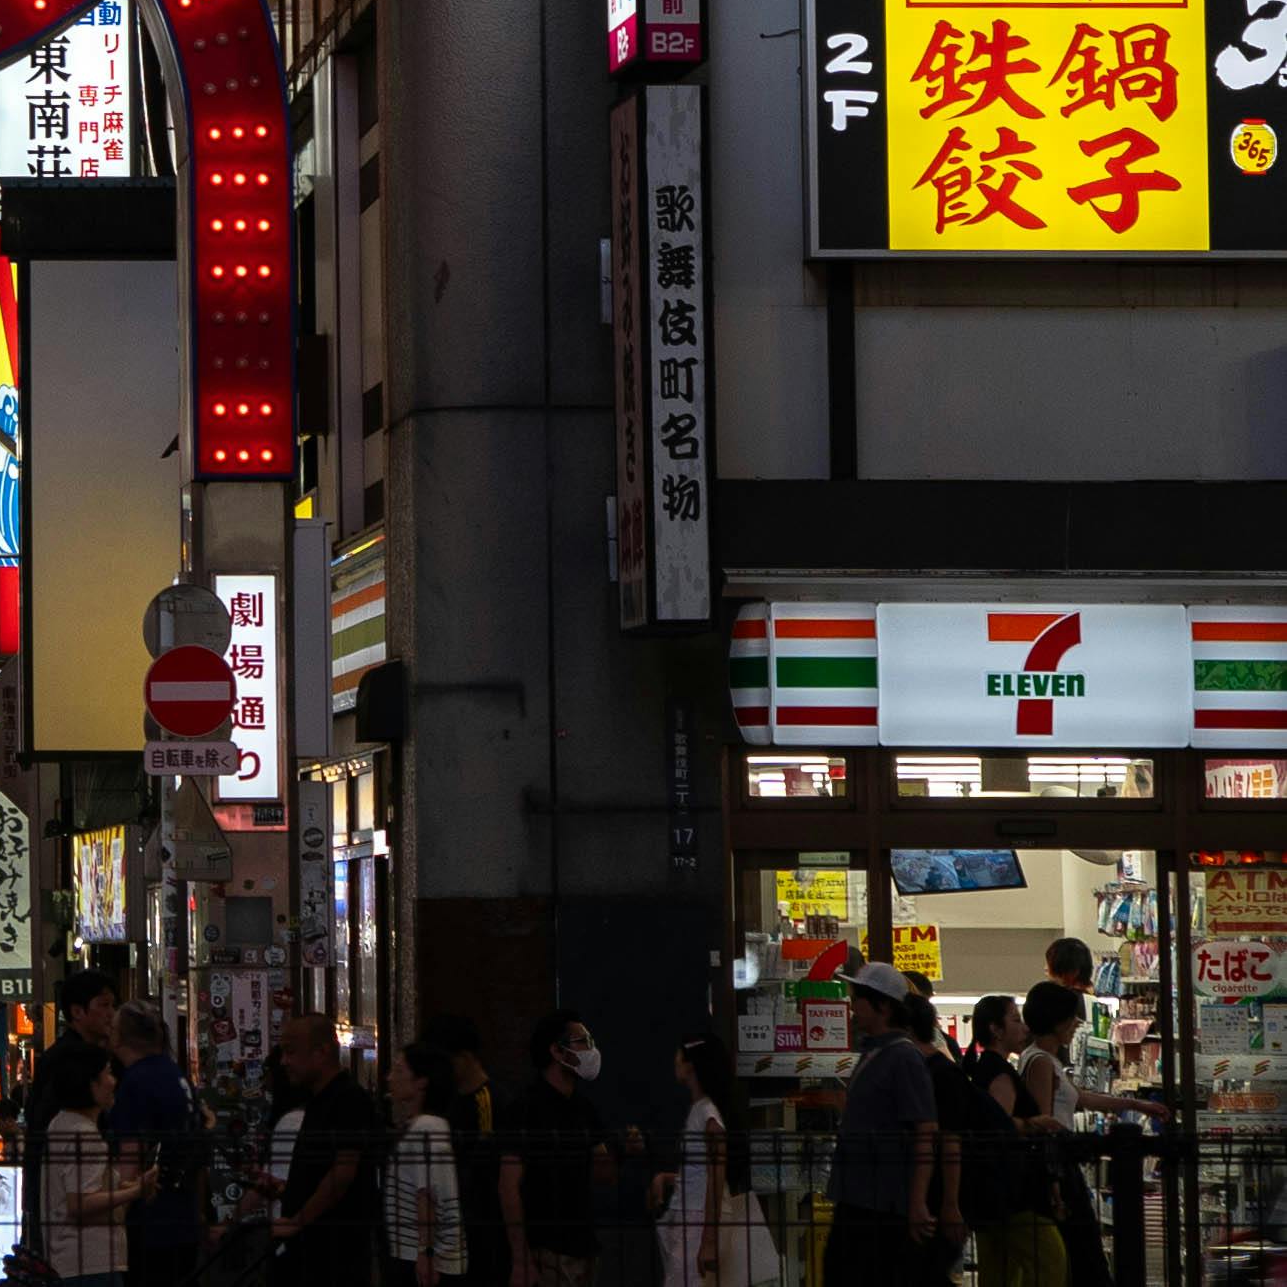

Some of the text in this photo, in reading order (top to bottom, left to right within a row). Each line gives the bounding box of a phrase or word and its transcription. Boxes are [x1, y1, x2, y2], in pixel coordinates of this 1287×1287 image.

[651, 31, 695, 55] B2F
[823, 33, 879, 132] 2F
[911, 19, 1179, 122] 鉄鍋
[102, 33, 124, 161] リーチ麻雀
[77, 84, 101, 178] 専門店
[1238, 131, 1270, 169] 365
[912, 127, 1183, 234] 餃子
[655, 184, 700, 522] 歌舞伎町名物
[229, 591, 266, 782] 劇場通り
[151, 748, 232, 770] 自転車を除く
[674, 827, 695, 846] 17
[1208, 870, 1287, 890] ATM
[1197, 950, 1273, 982] たばこ
[1212, 984, 1259, 994] cigarette
[777, 1032, 802, 1047] SIM
